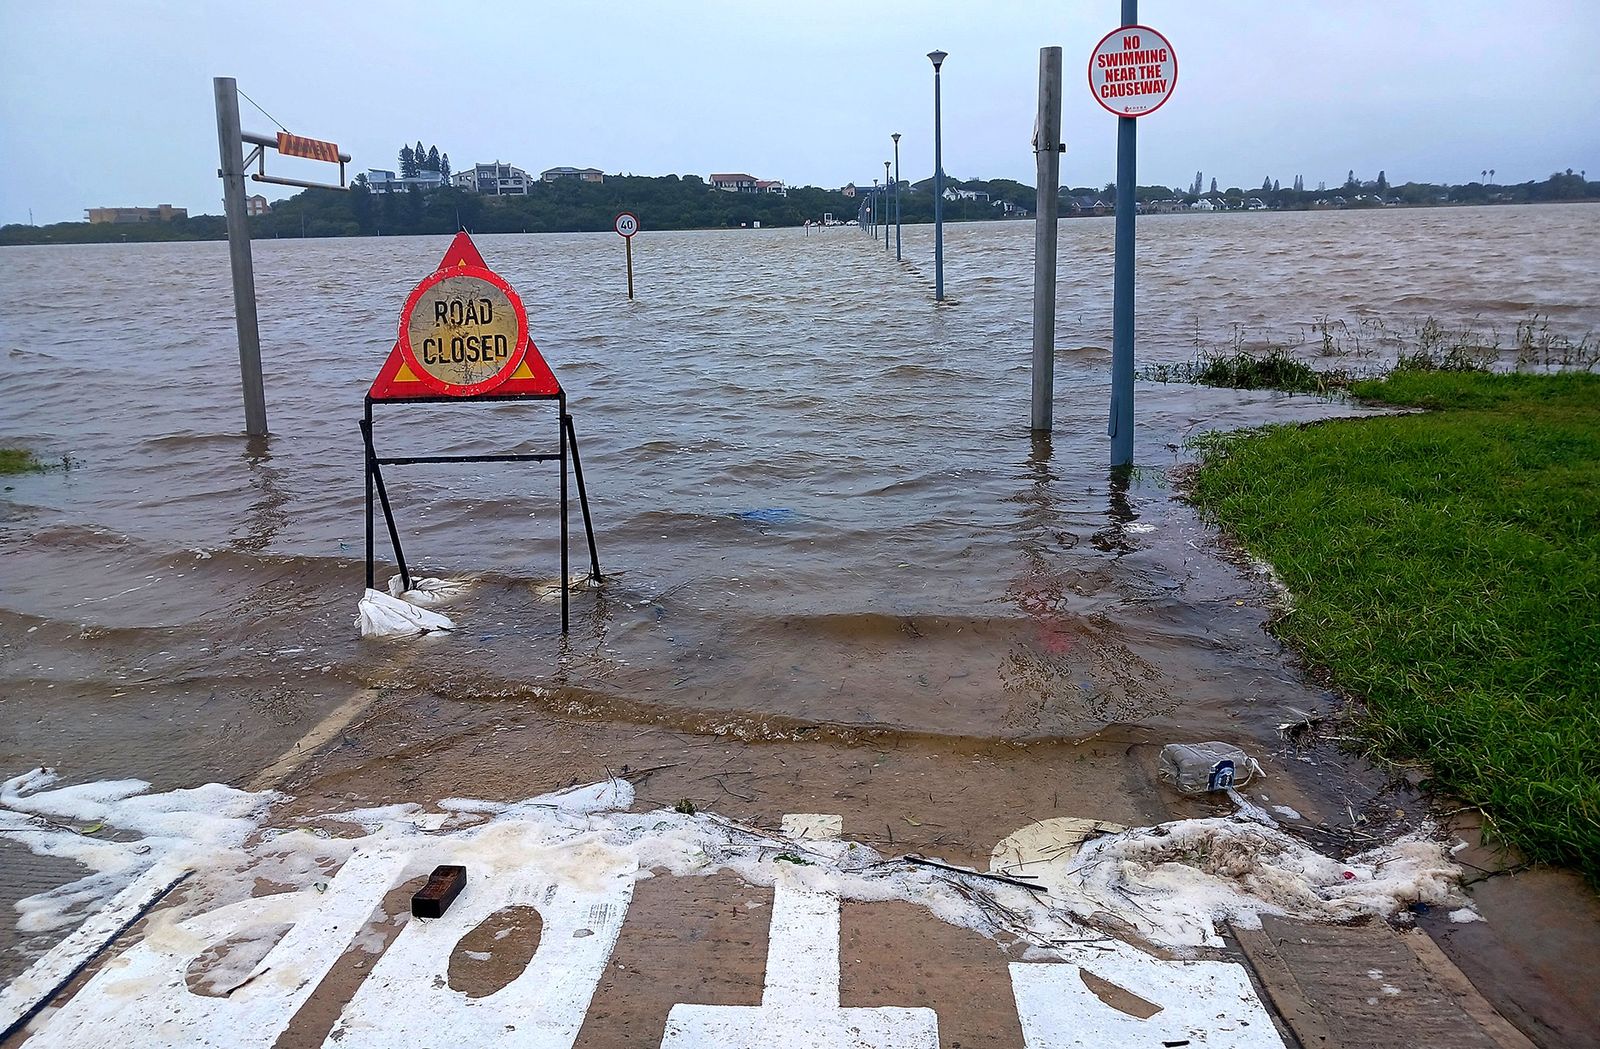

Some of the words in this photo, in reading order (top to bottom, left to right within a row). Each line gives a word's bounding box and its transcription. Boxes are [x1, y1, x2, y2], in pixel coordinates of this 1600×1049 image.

[1123, 35, 1140, 50] NO
[1097, 48, 1167, 68] SWIMMING
[1105, 67, 1137, 82] NEAR
[1138, 64, 1162, 79] THE
[1100, 79, 1167, 99] CAUSEWAY
[620, 220, 633, 230] 40
[434, 298, 493, 328] ROAD
[423, 334, 508, 365] CLOSED
